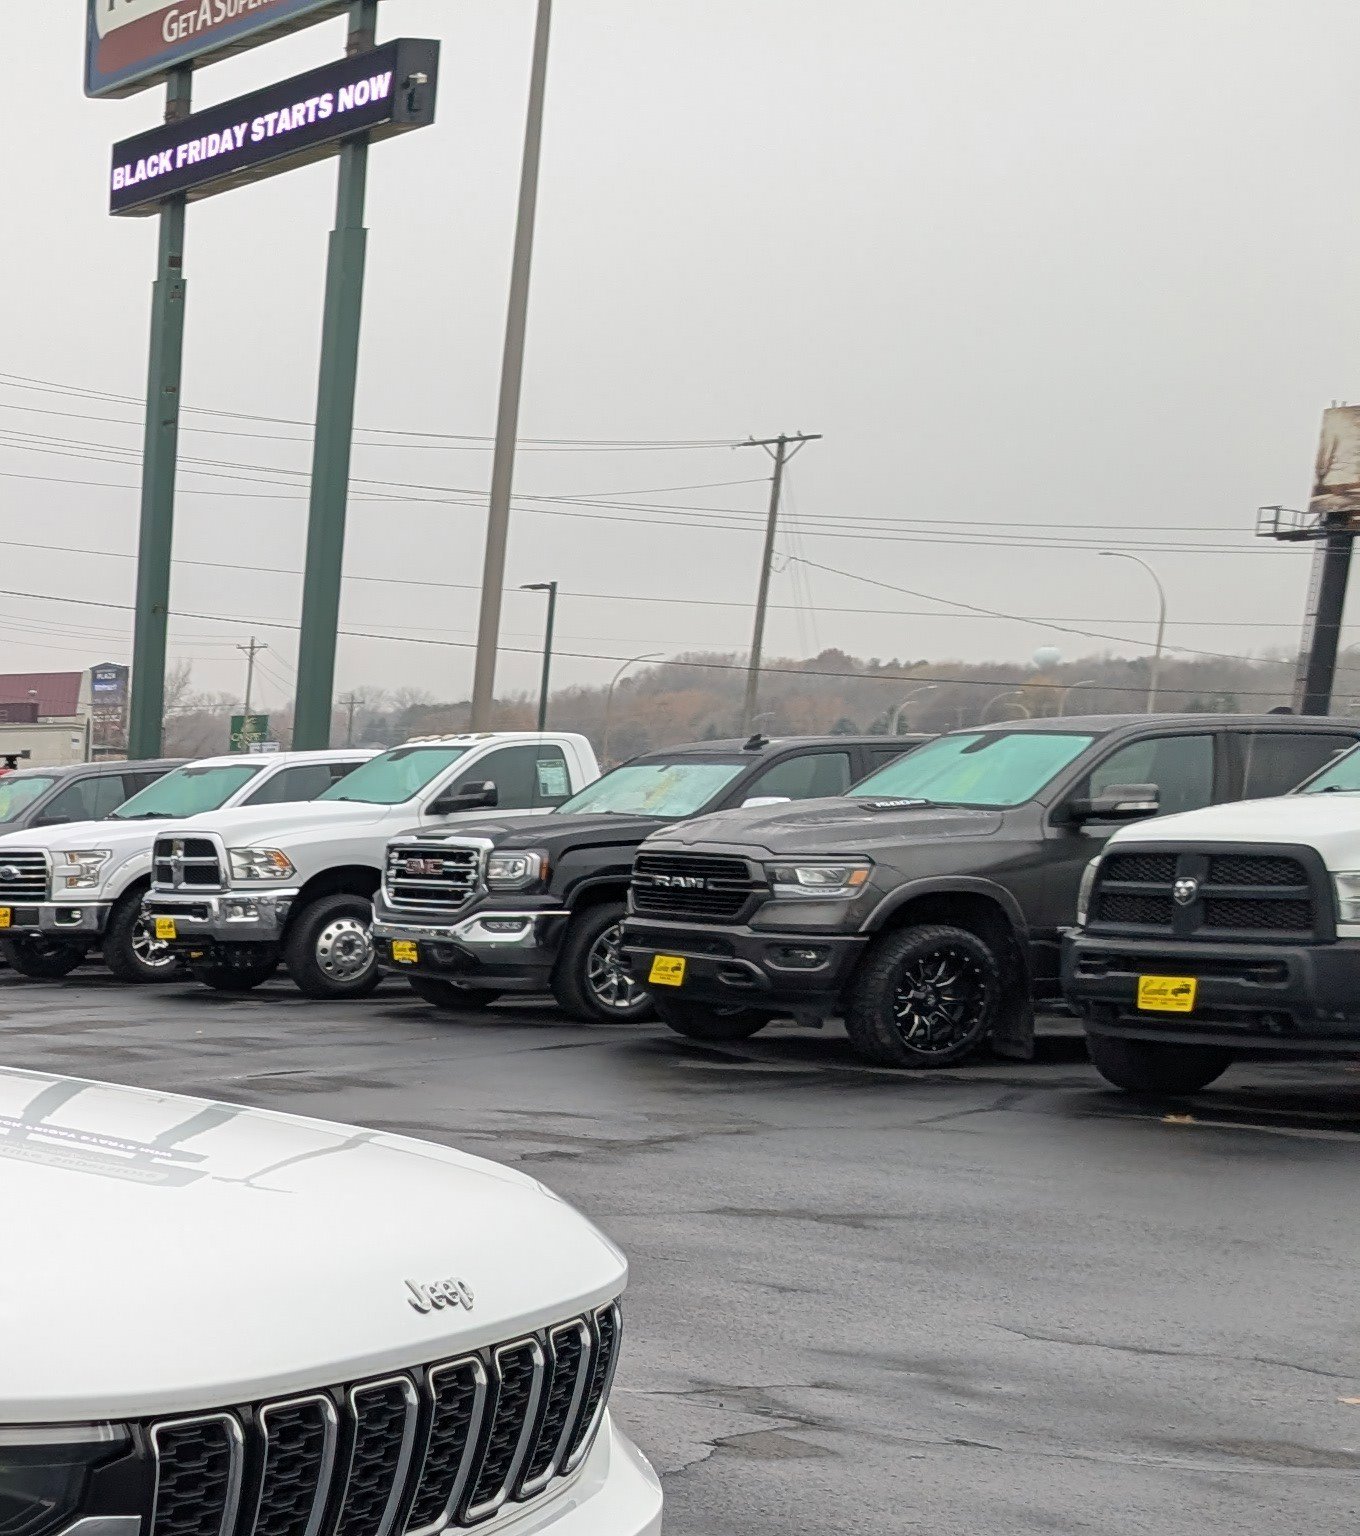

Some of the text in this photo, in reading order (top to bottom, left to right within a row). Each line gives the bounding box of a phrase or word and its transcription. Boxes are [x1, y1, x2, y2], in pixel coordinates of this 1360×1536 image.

[113, 70, 393, 191] BLACK FRIDAY STARTS NOW
[654, 875, 704, 888] RAM
[404, 1277, 475, 1315] Jeep
